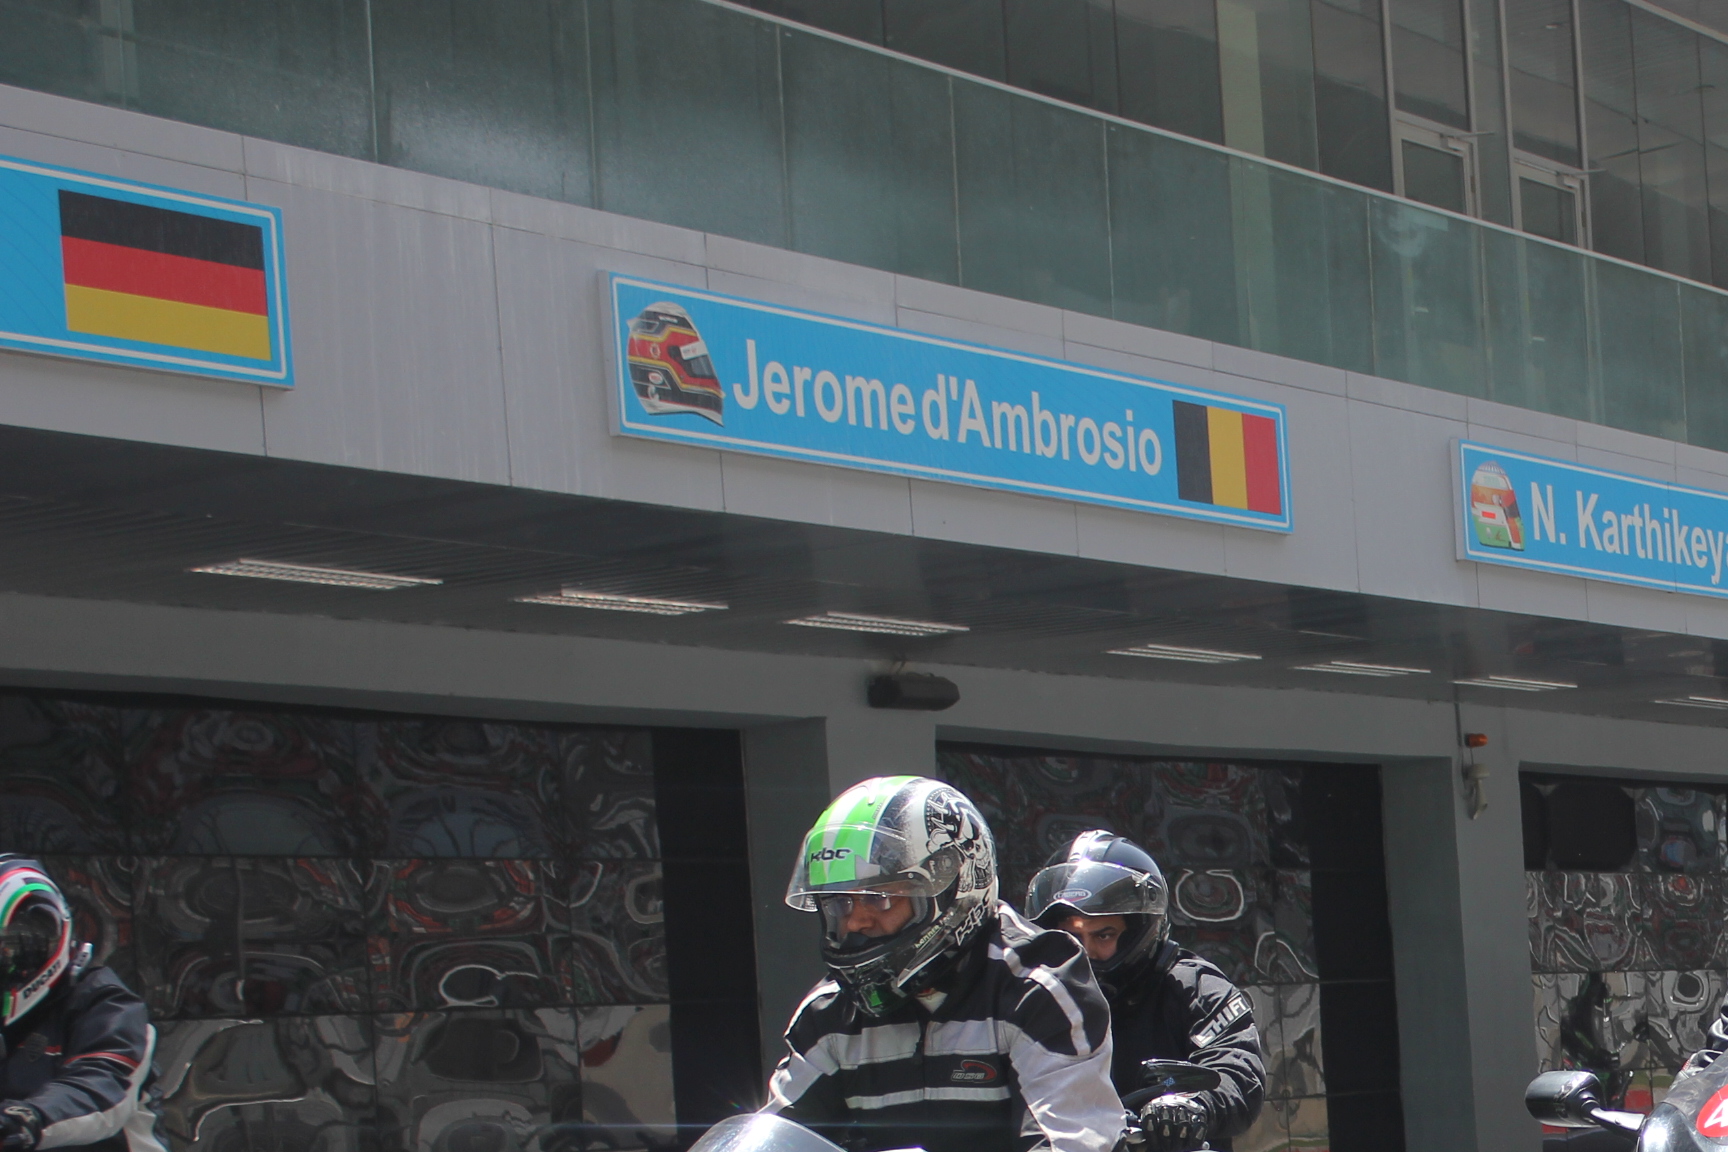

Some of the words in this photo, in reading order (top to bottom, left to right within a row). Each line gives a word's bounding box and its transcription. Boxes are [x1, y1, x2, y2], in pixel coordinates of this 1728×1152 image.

[733, 338, 916, 436] Jerome
[921, 373, 1163, 477] d'Ambrosio
[1529, 481, 1567, 546] N.
[1195, 995, 1250, 1044] SHIFT
